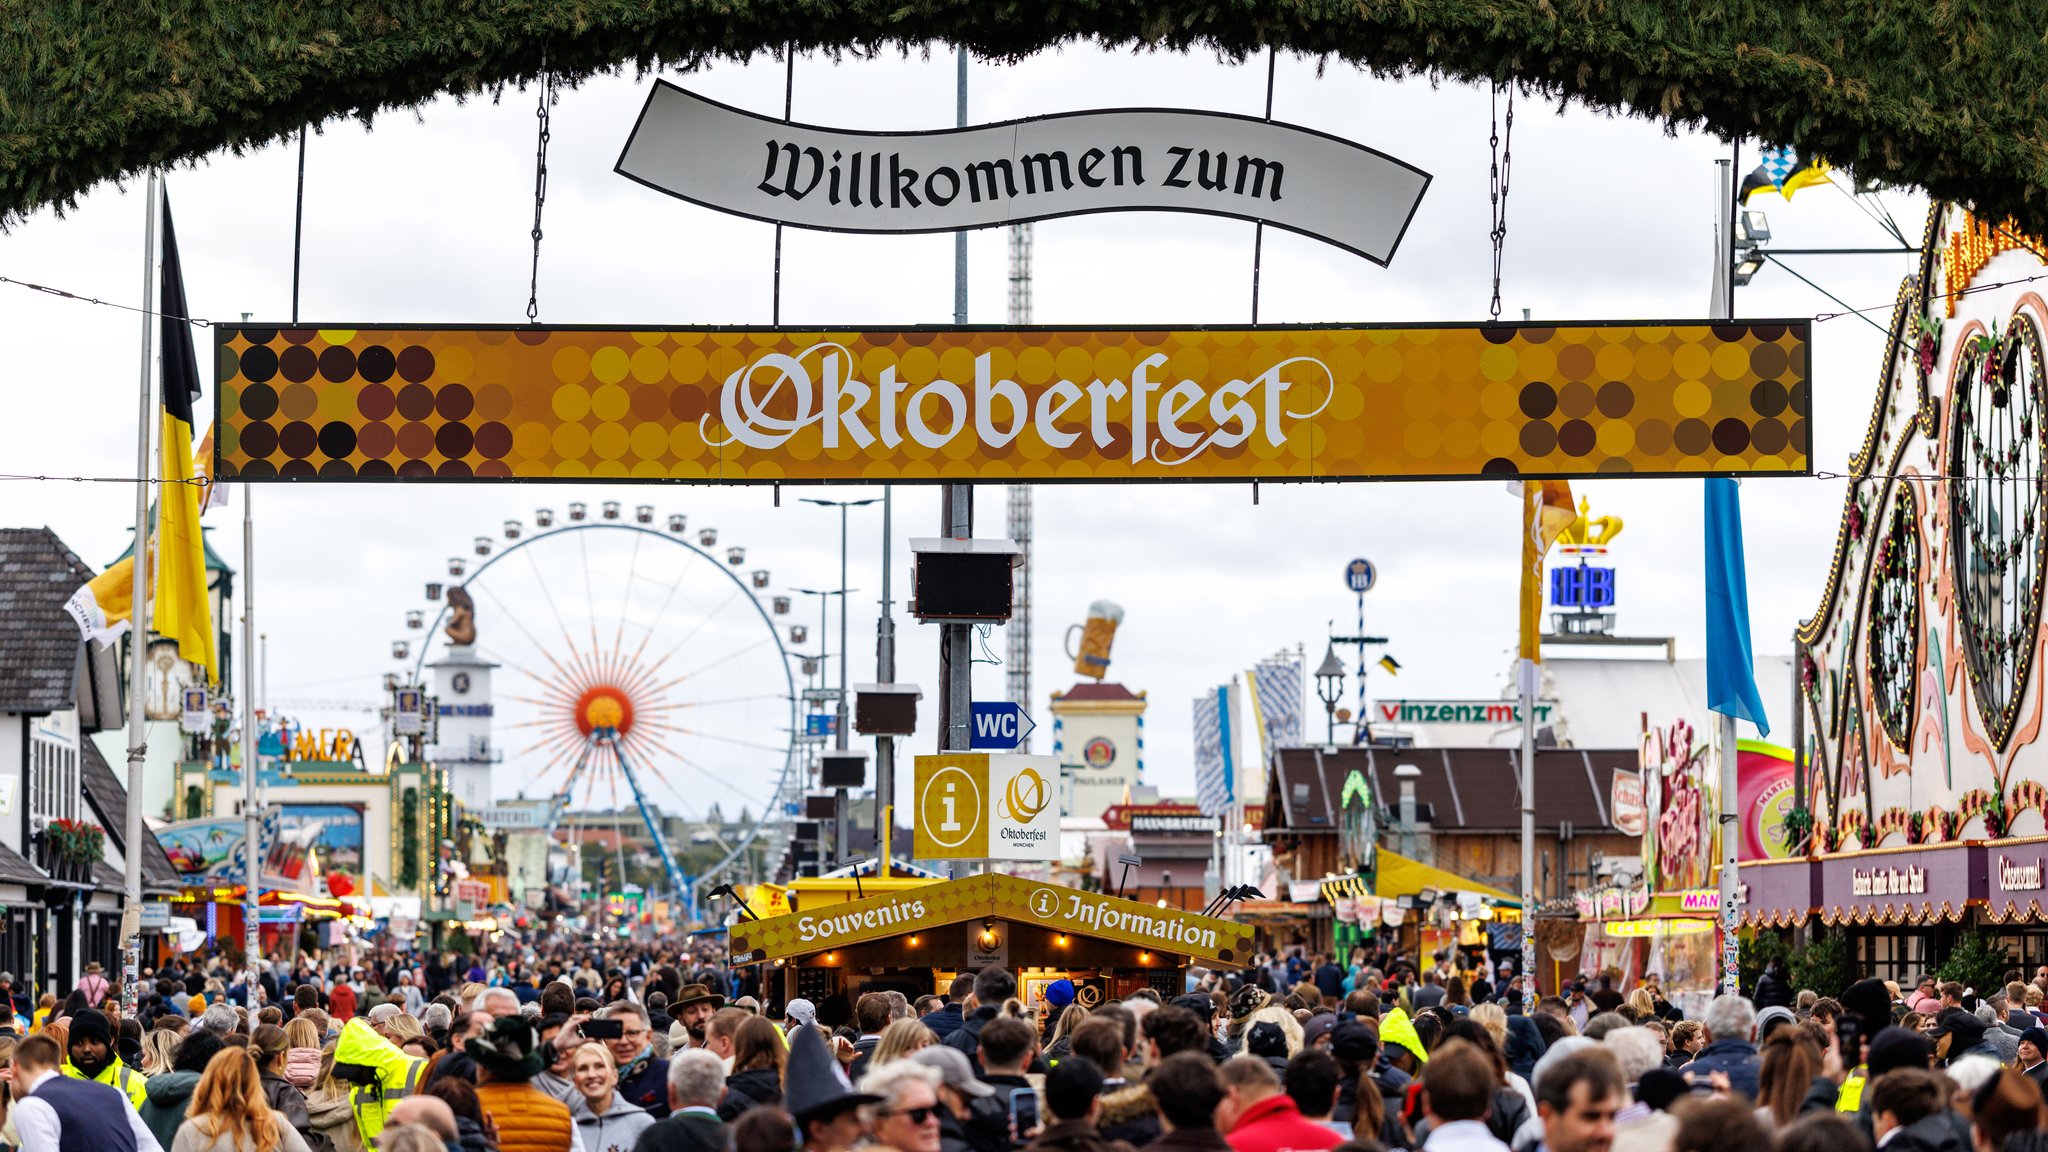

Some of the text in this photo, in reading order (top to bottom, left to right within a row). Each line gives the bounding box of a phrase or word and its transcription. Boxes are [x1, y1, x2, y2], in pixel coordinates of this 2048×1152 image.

[757, 139, 1286, 209] Willkommen zum
[700, 342, 1334, 466] Oktoberfest
[976, 713, 1016, 738] WC
[1000, 827, 1047, 842] Oktoberfest
[1999, 854, 2041, 892] Ochsensemmel
[798, 898, 926, 942] Souvenirs
[1063, 894, 1217, 949] Information
